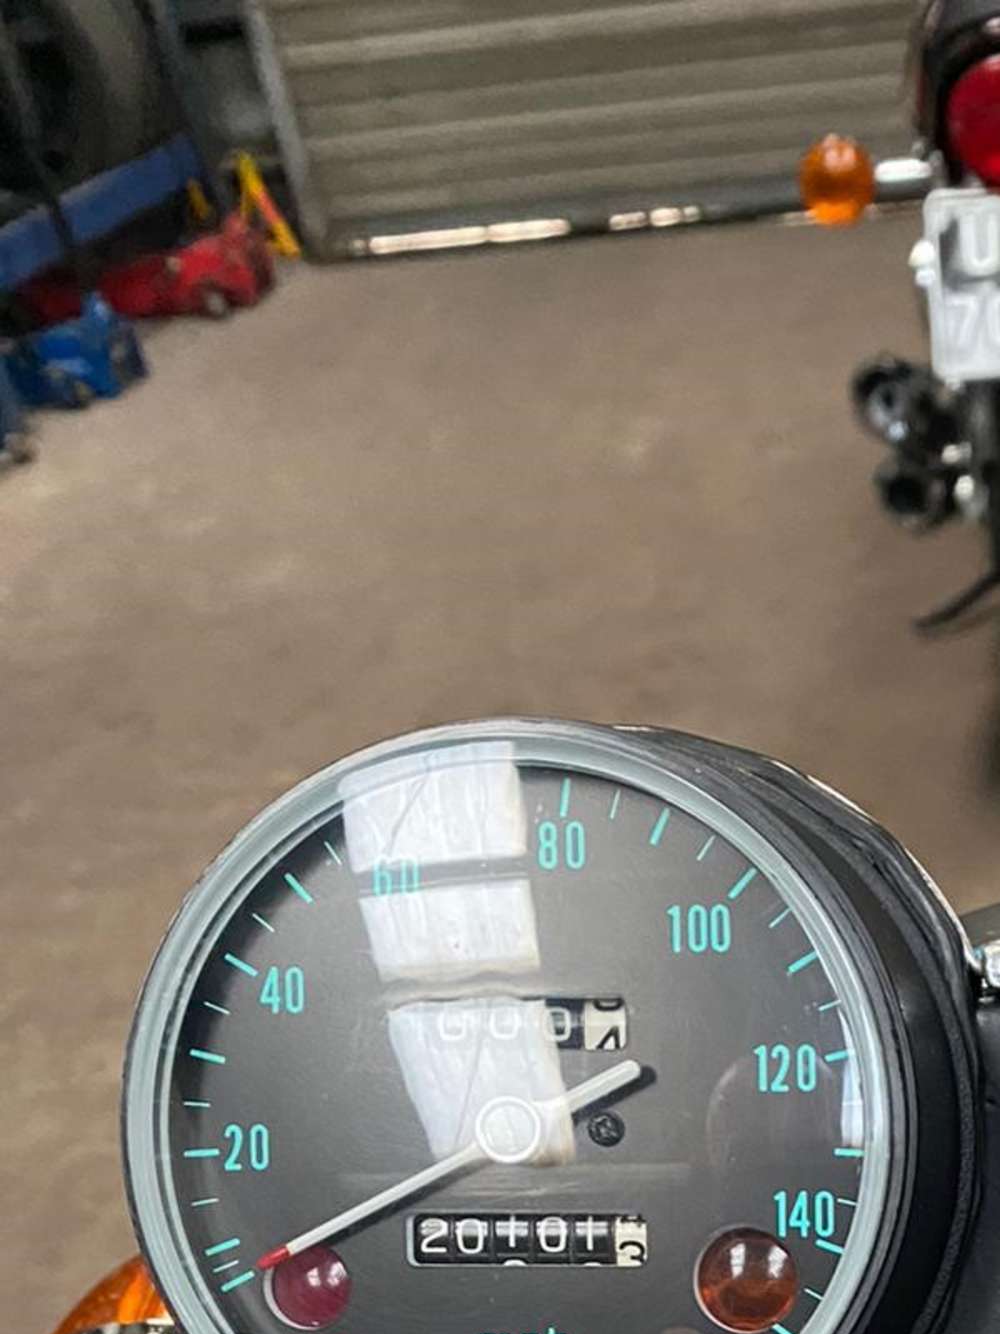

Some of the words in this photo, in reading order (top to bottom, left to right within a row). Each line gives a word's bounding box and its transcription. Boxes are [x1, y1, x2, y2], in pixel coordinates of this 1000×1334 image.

[537, 821, 586, 871] 80
[373, 854, 420, 899] 60
[666, 903, 732, 953] 100
[259, 966, 305, 1014] 40
[753, 1044, 817, 1092] 120
[223, 1123, 270, 1171] 20
[773, 1190, 836, 1238] 140
